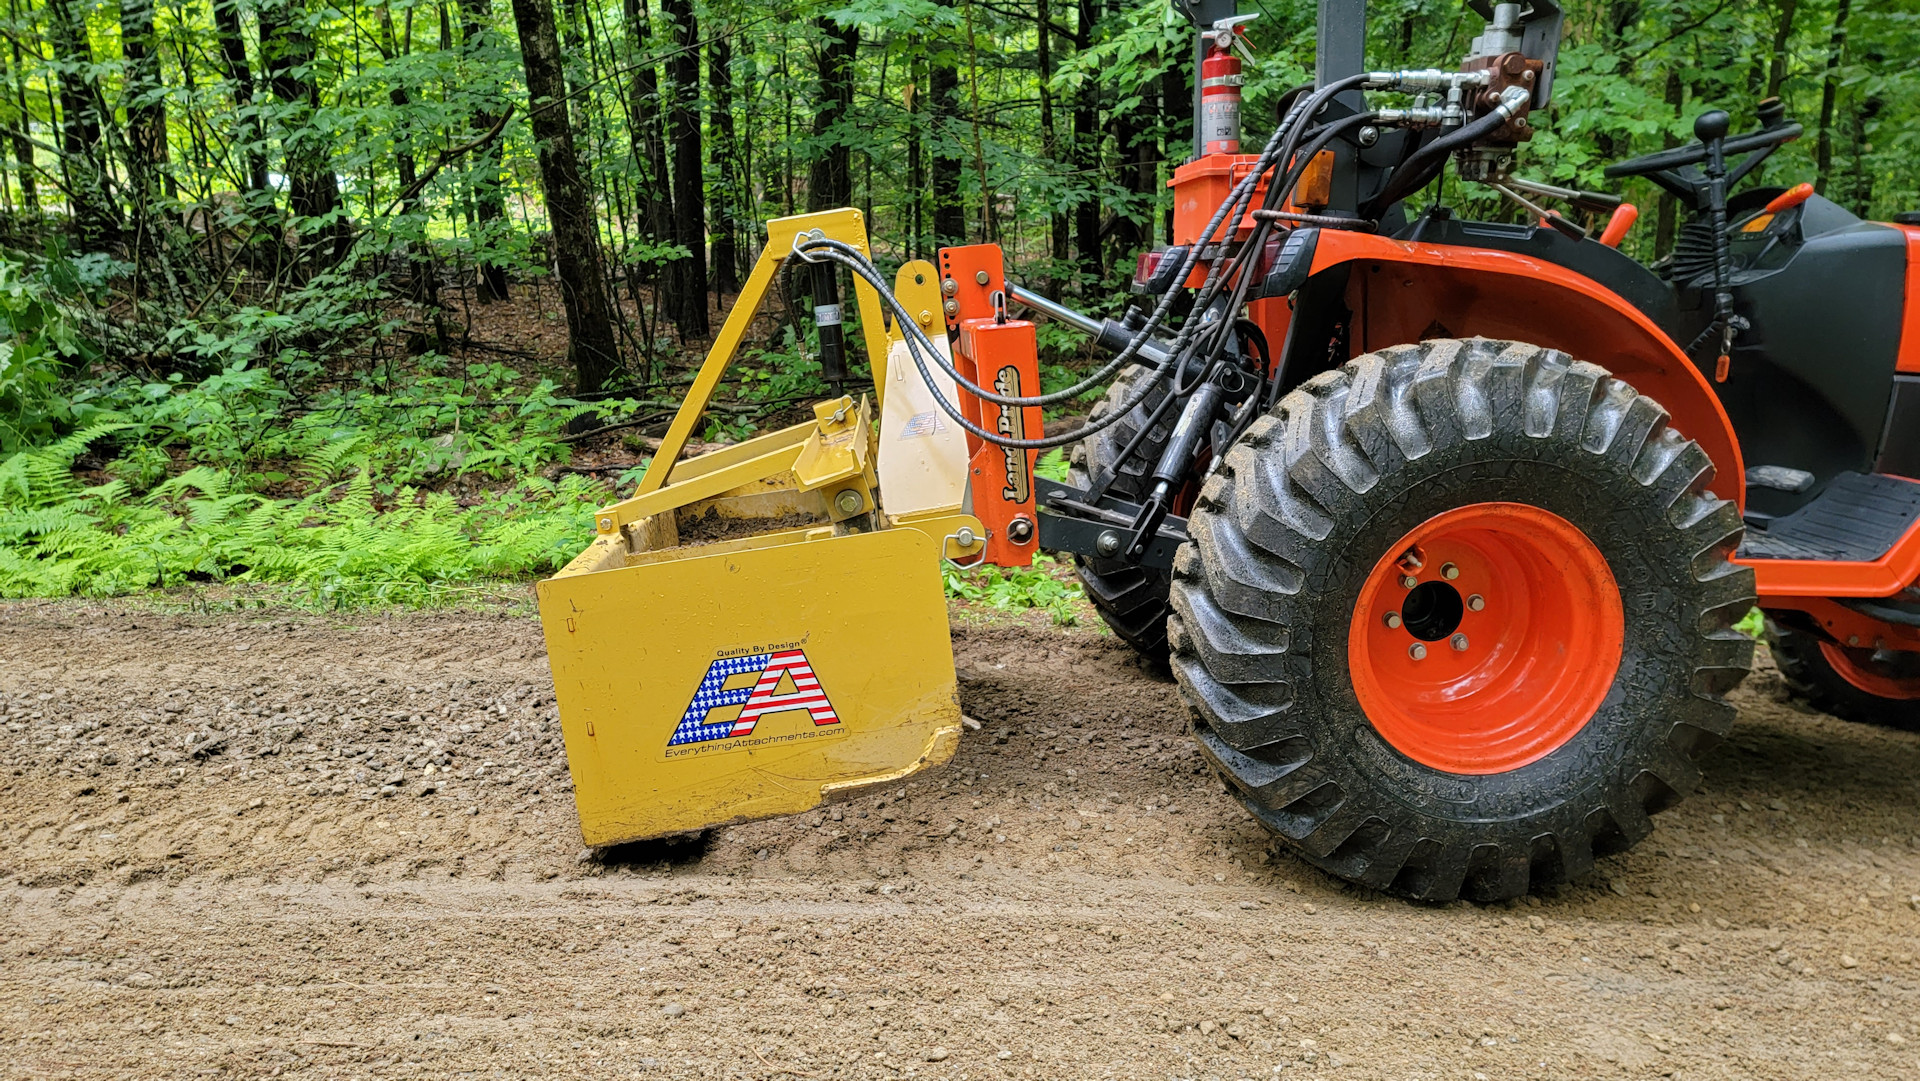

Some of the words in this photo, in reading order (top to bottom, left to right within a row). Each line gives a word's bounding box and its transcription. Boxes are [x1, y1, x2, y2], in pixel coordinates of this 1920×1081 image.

[994, 367, 1017, 435] Prde
[1000, 443, 1022, 502] Land
[717, 647, 750, 657] Quality
[753, 645, 765, 654] By
[667, 648, 841, 746] EA
[665, 727, 845, 758] EverythingAttachments.com
